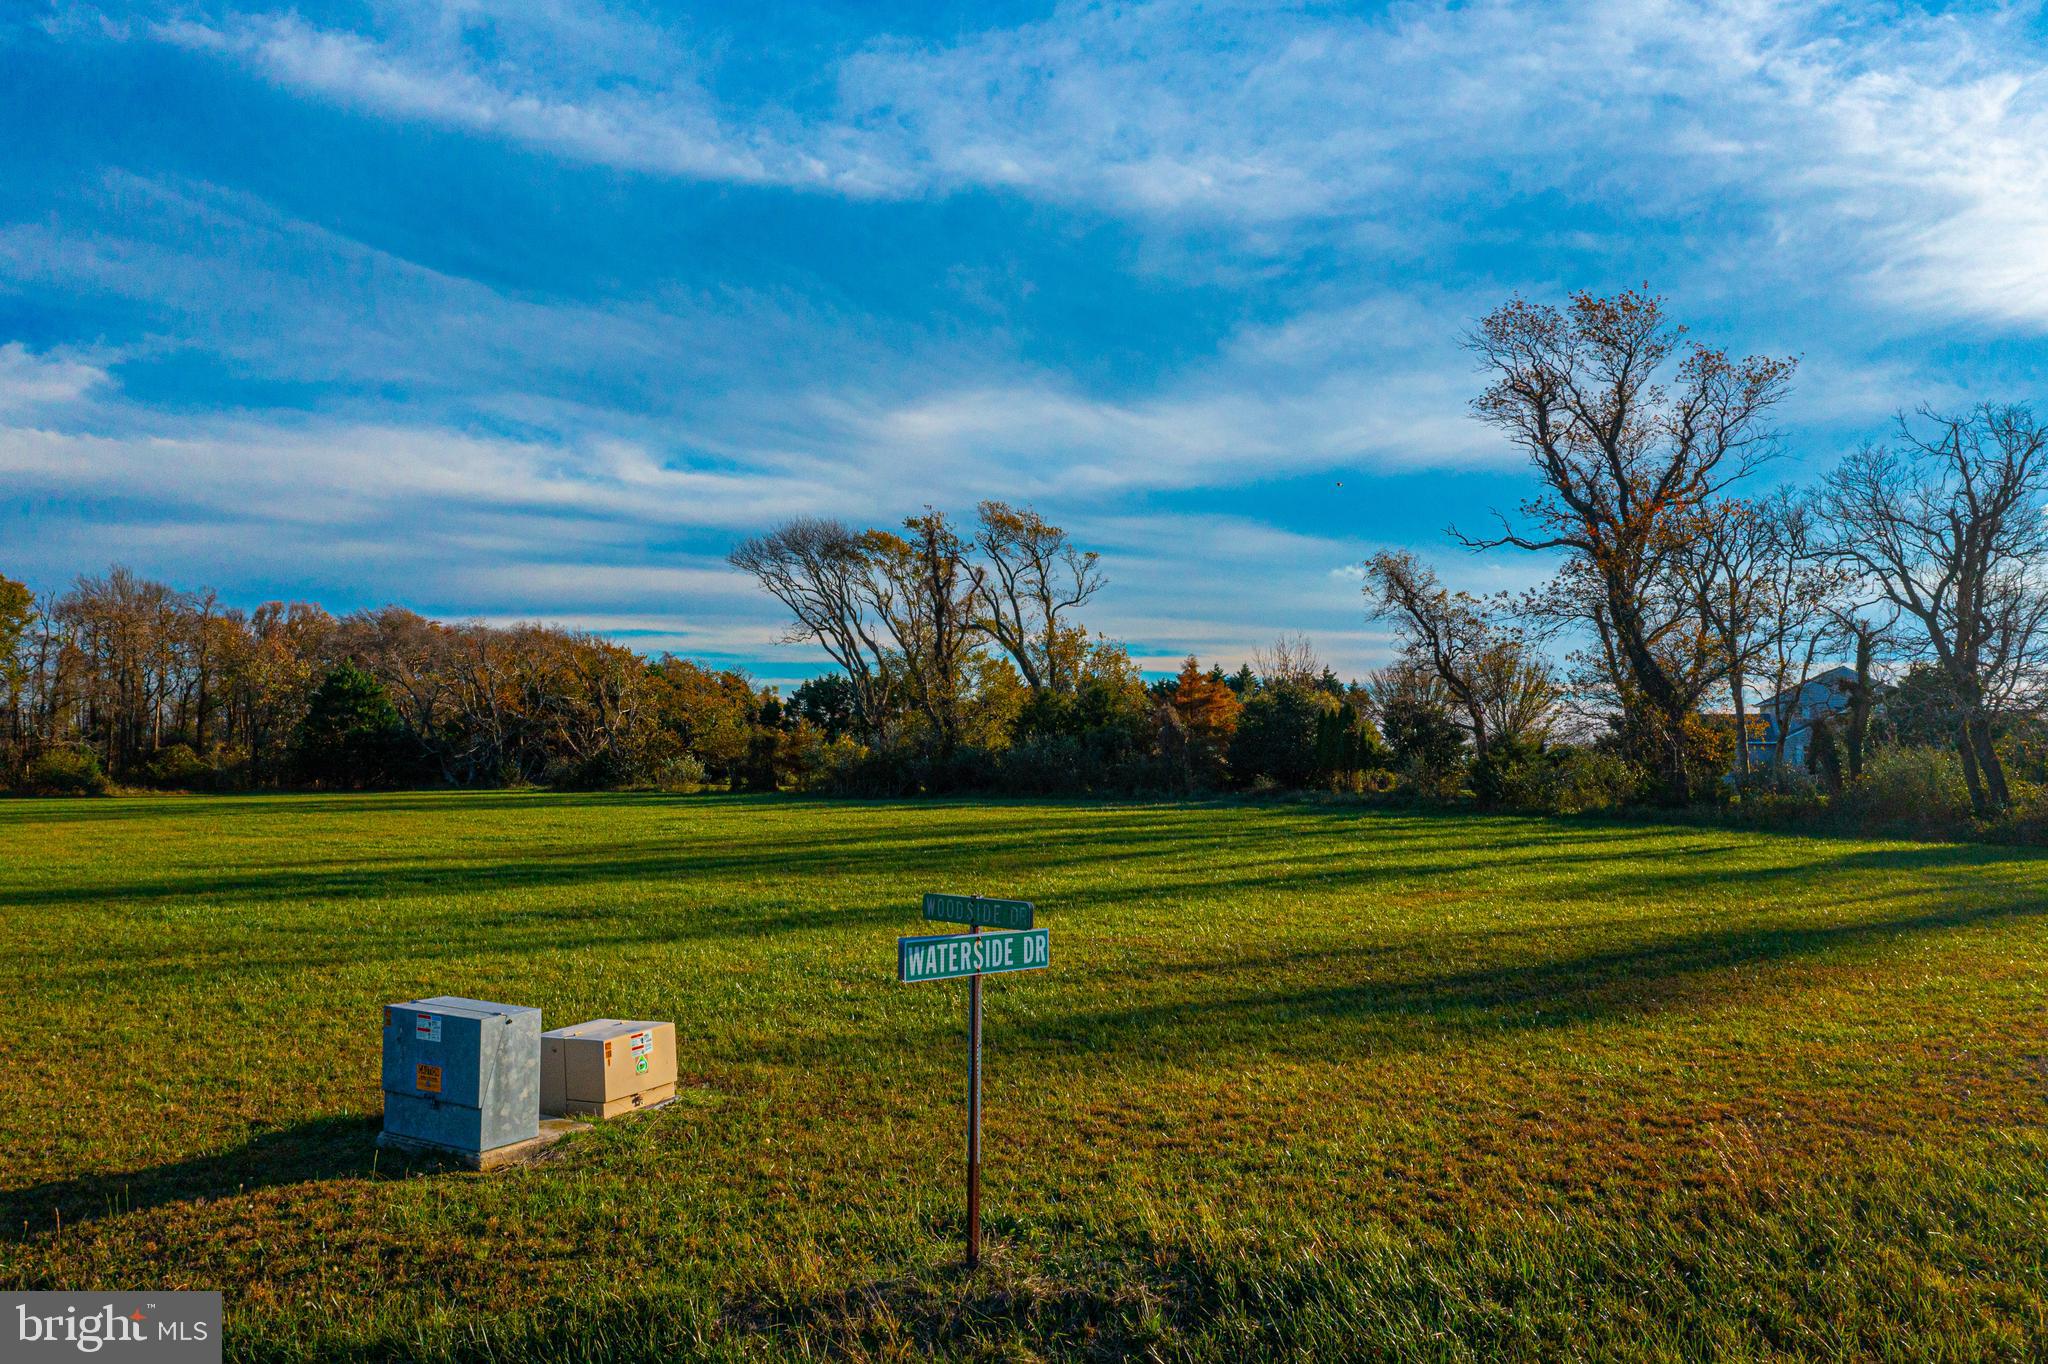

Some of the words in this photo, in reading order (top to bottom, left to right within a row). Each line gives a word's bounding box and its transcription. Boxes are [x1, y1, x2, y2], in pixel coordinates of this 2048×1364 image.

[926, 897, 1001, 924] WOODSIDE
[1010, 906, 1028, 927] DR
[908, 937, 1014, 977] WATERSIDE
[1023, 935, 1046, 964] DR
